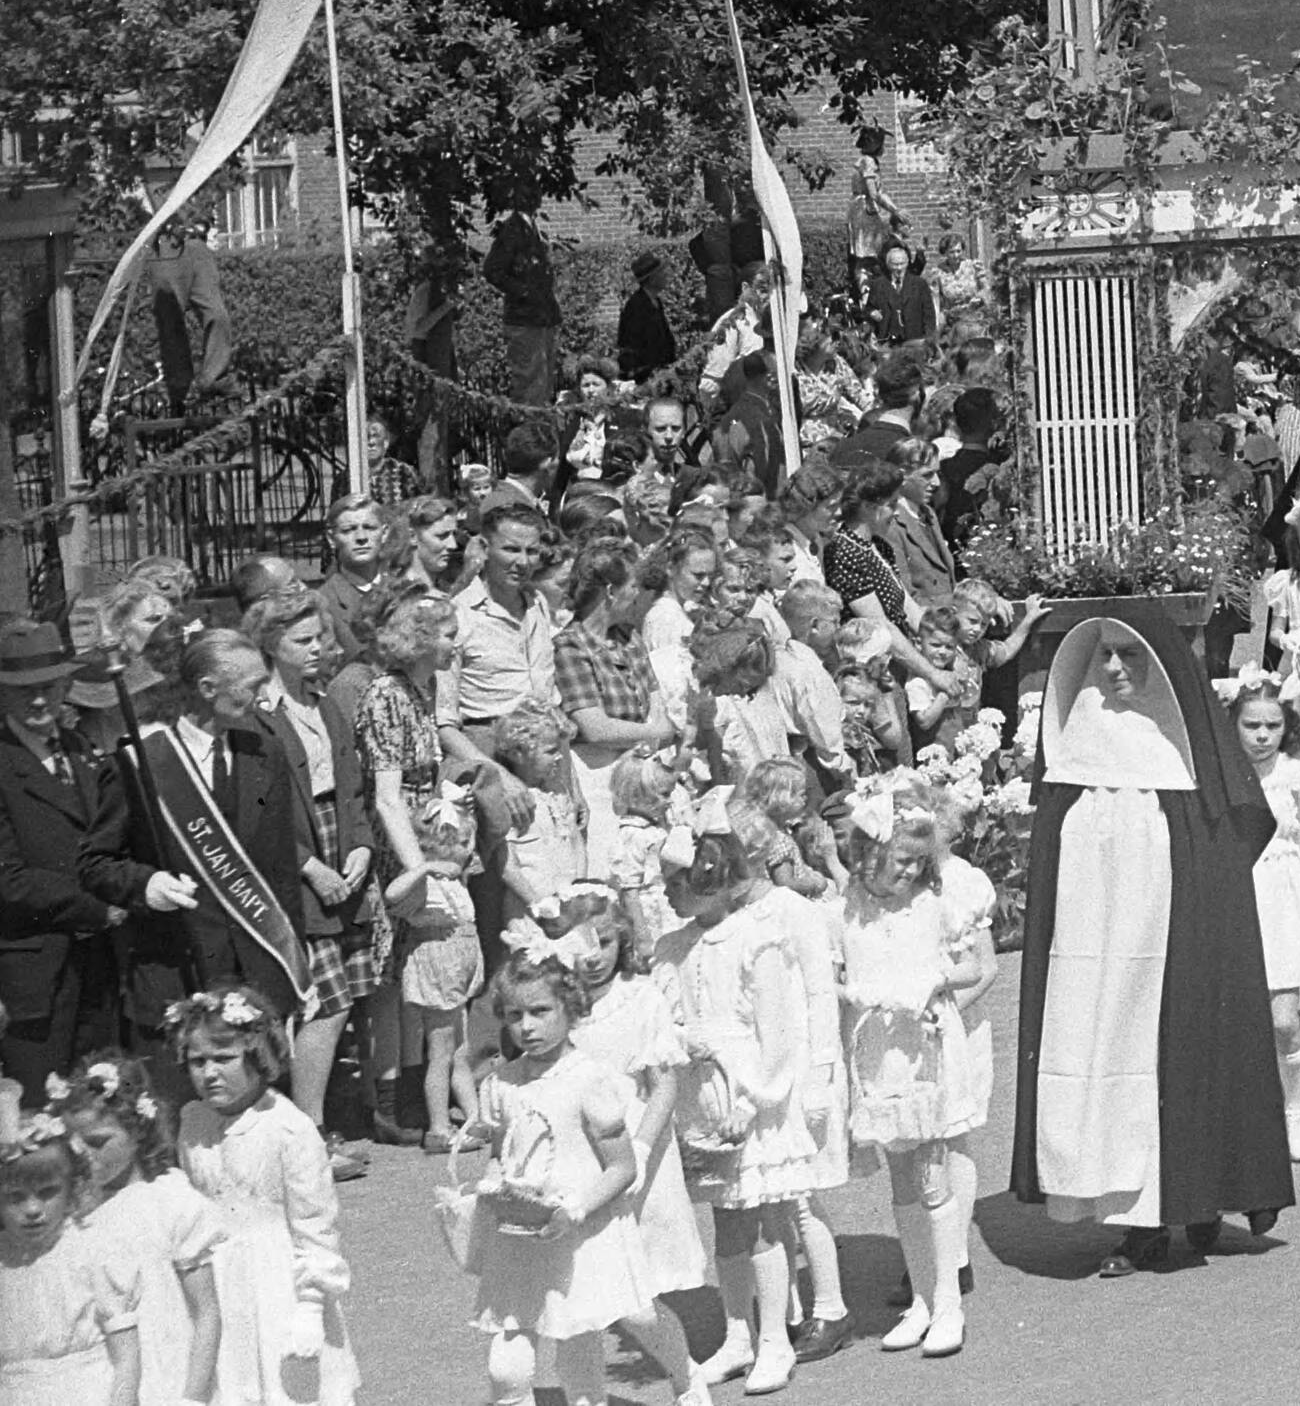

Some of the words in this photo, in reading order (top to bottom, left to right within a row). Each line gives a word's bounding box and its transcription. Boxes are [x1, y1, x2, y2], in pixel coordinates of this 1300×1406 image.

[187, 817, 213, 844] ST.
[202, 844, 238, 880] JAN
[228, 877, 270, 923] BAPT.
